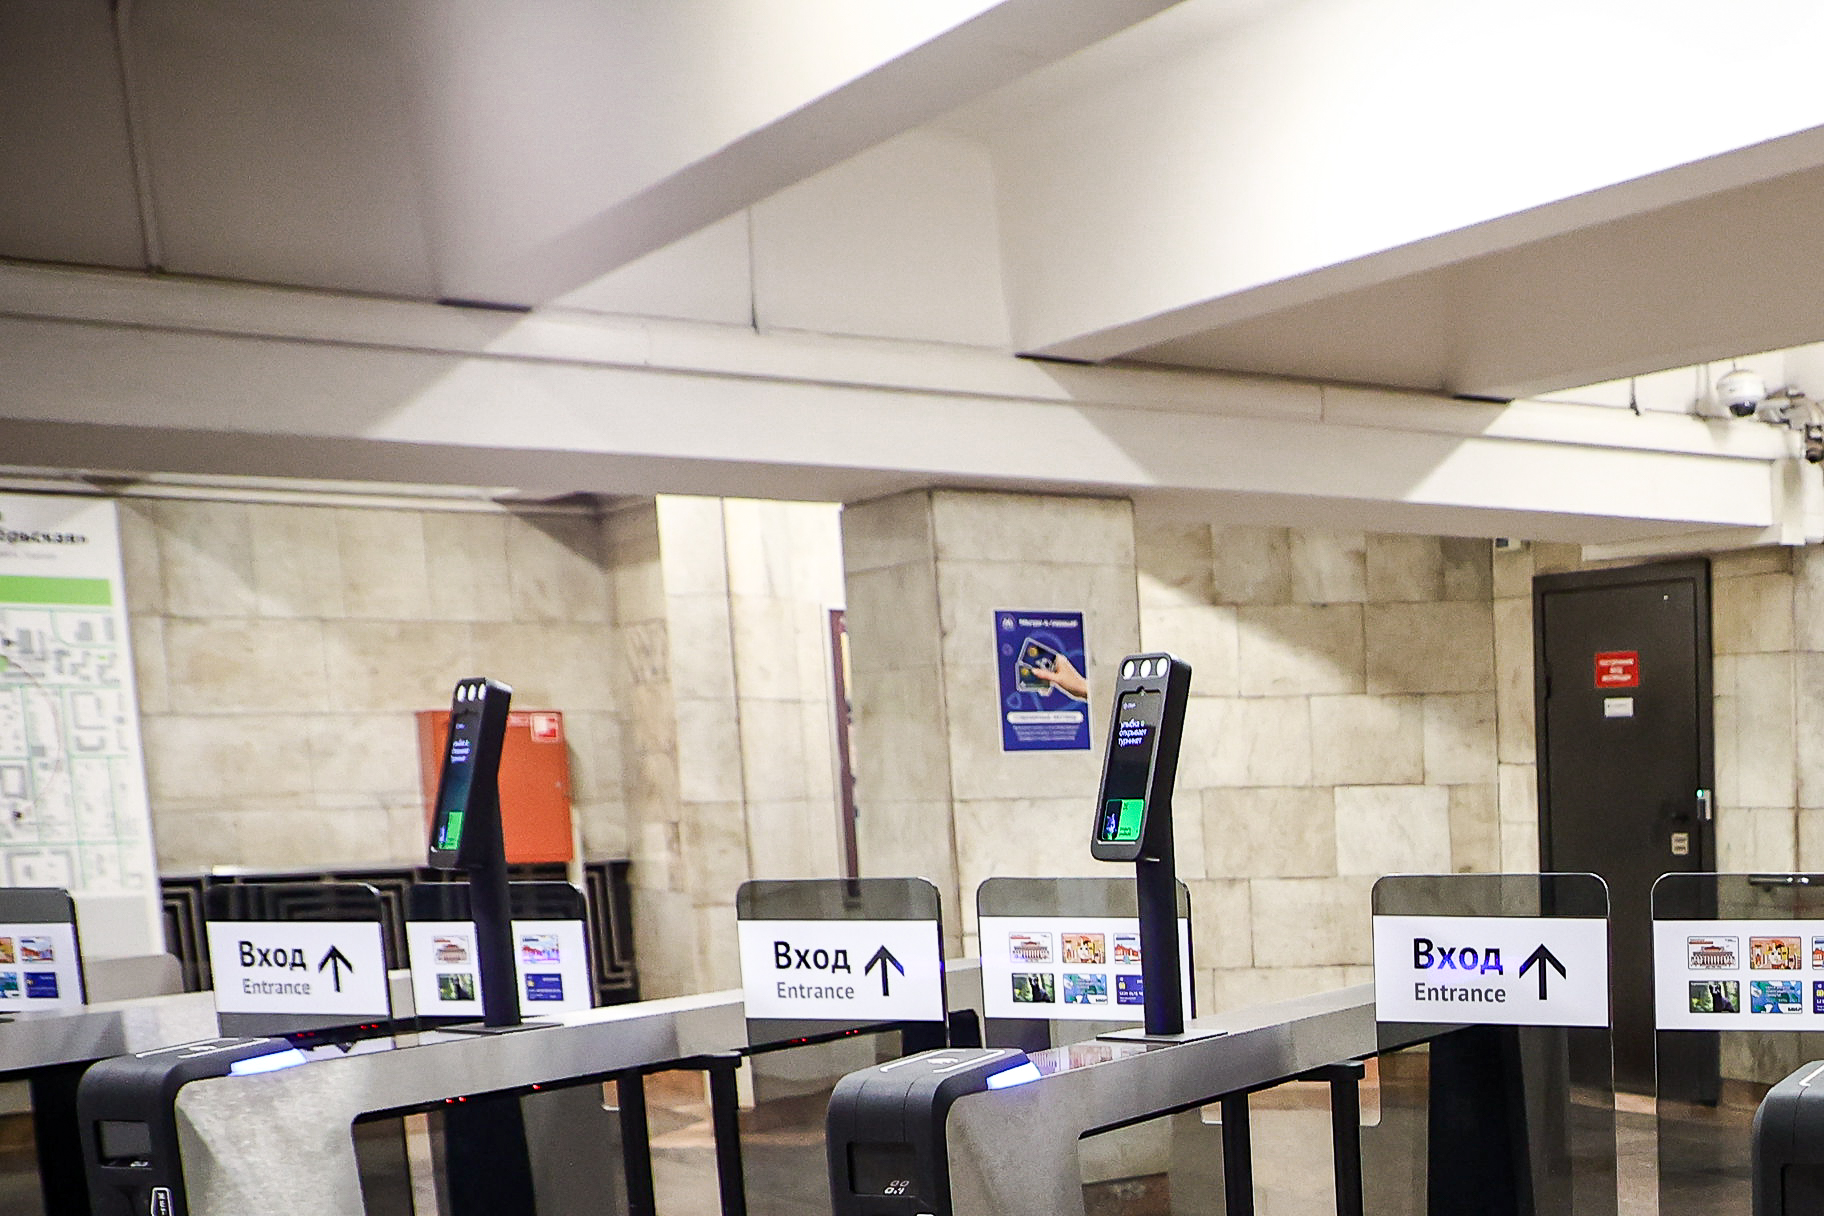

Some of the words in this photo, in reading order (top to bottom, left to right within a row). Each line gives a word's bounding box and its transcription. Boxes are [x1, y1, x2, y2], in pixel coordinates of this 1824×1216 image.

[238, 940, 307, 971] Вход
[773, 940, 852, 975] Вход
[1413, 937, 1504, 976] Вход
[243, 977, 311, 996] Entrance
[776, 981, 855, 1000] Entrance
[1414, 982, 1507, 1004] Entrance
